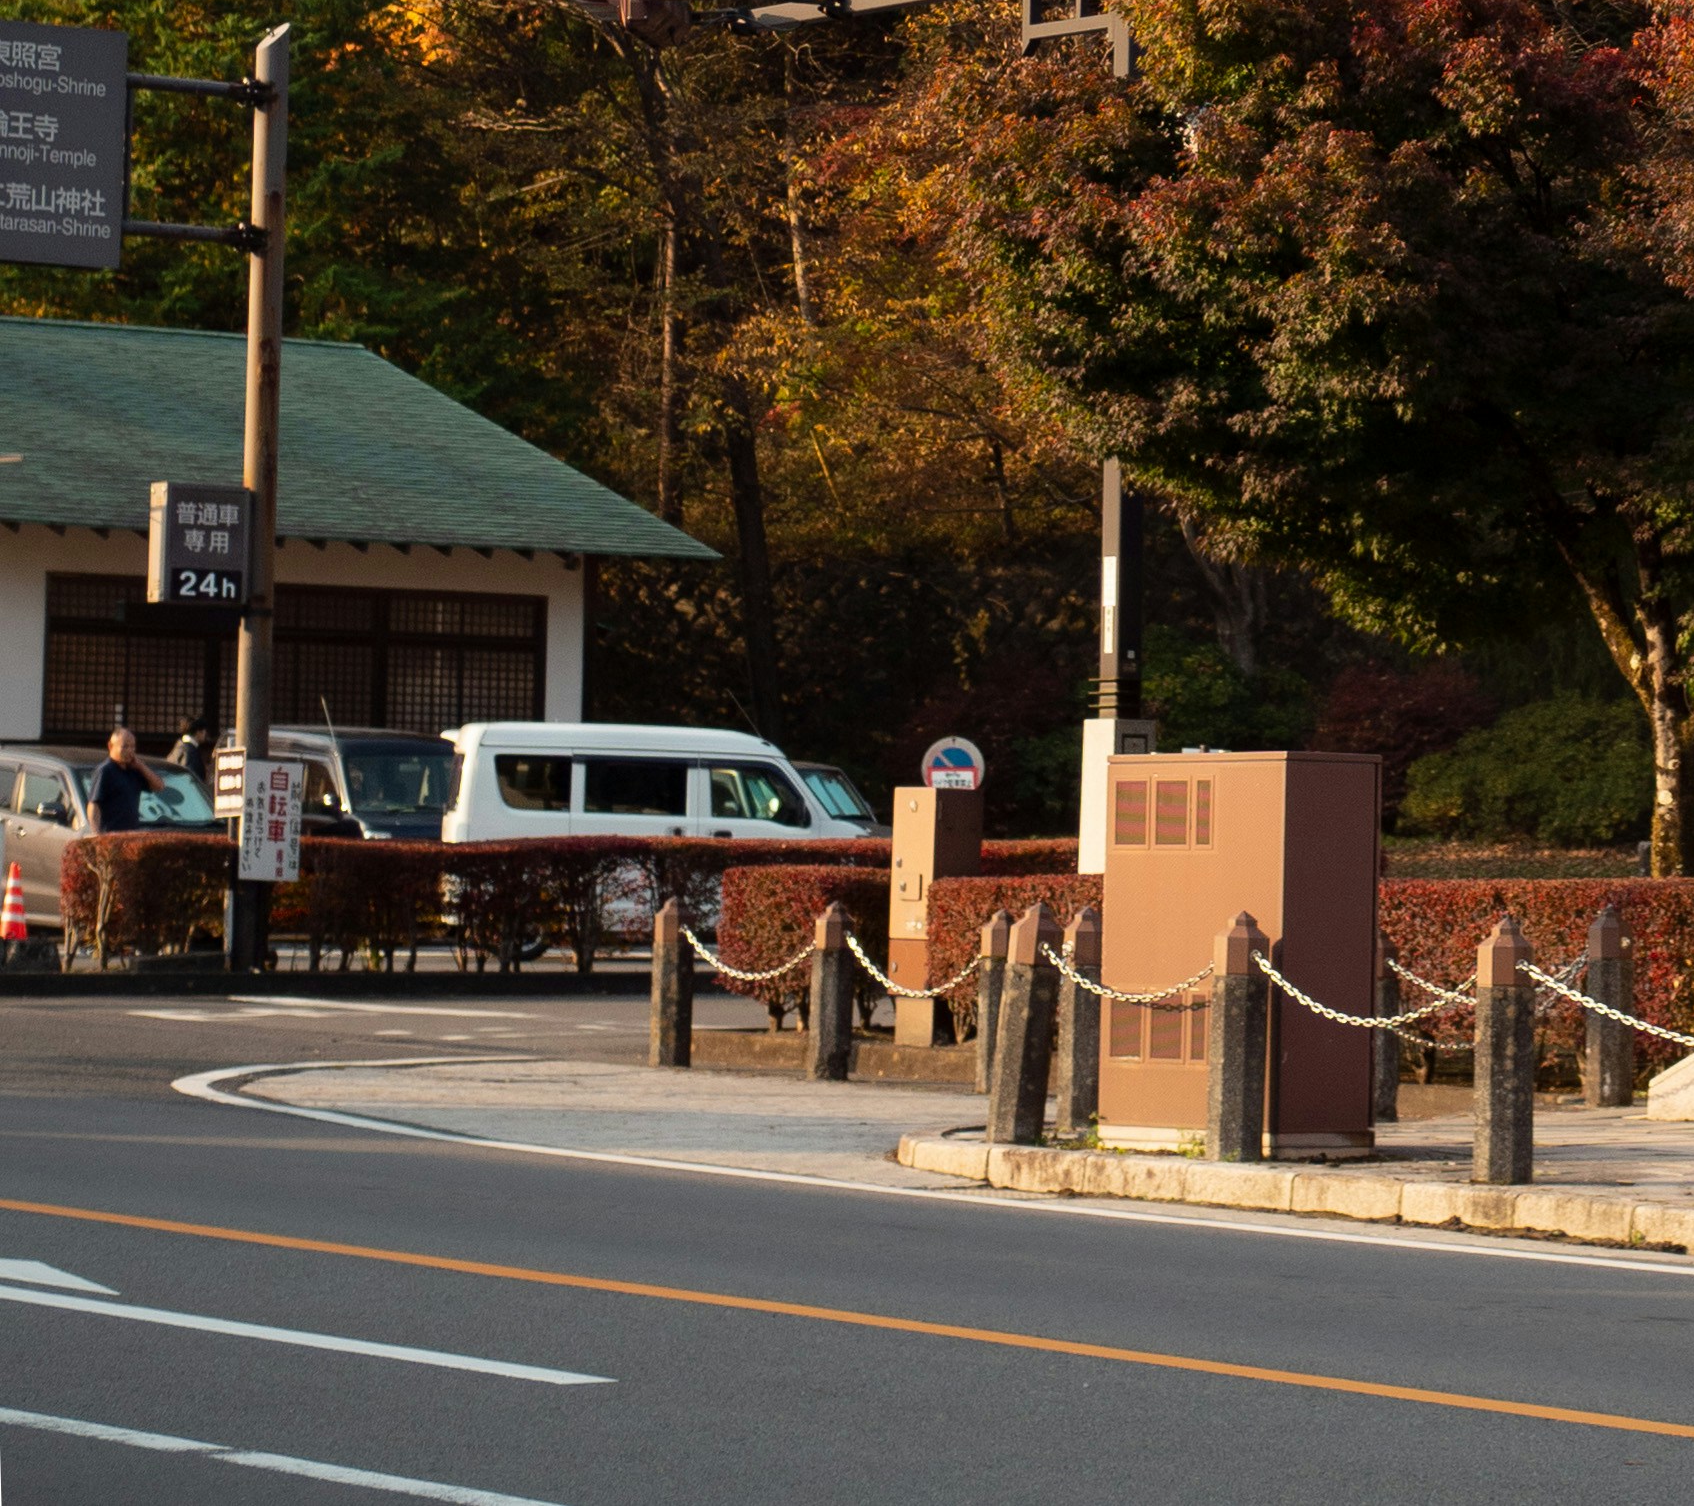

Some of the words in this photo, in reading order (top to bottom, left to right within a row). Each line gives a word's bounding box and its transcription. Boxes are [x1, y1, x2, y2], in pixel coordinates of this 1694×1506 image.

[0, 182, 106, 217] 荒山神社
[176, 501, 239, 527] 普通車
[184, 529, 230, 554] 専用
[179, 570, 236, 599] 24h
